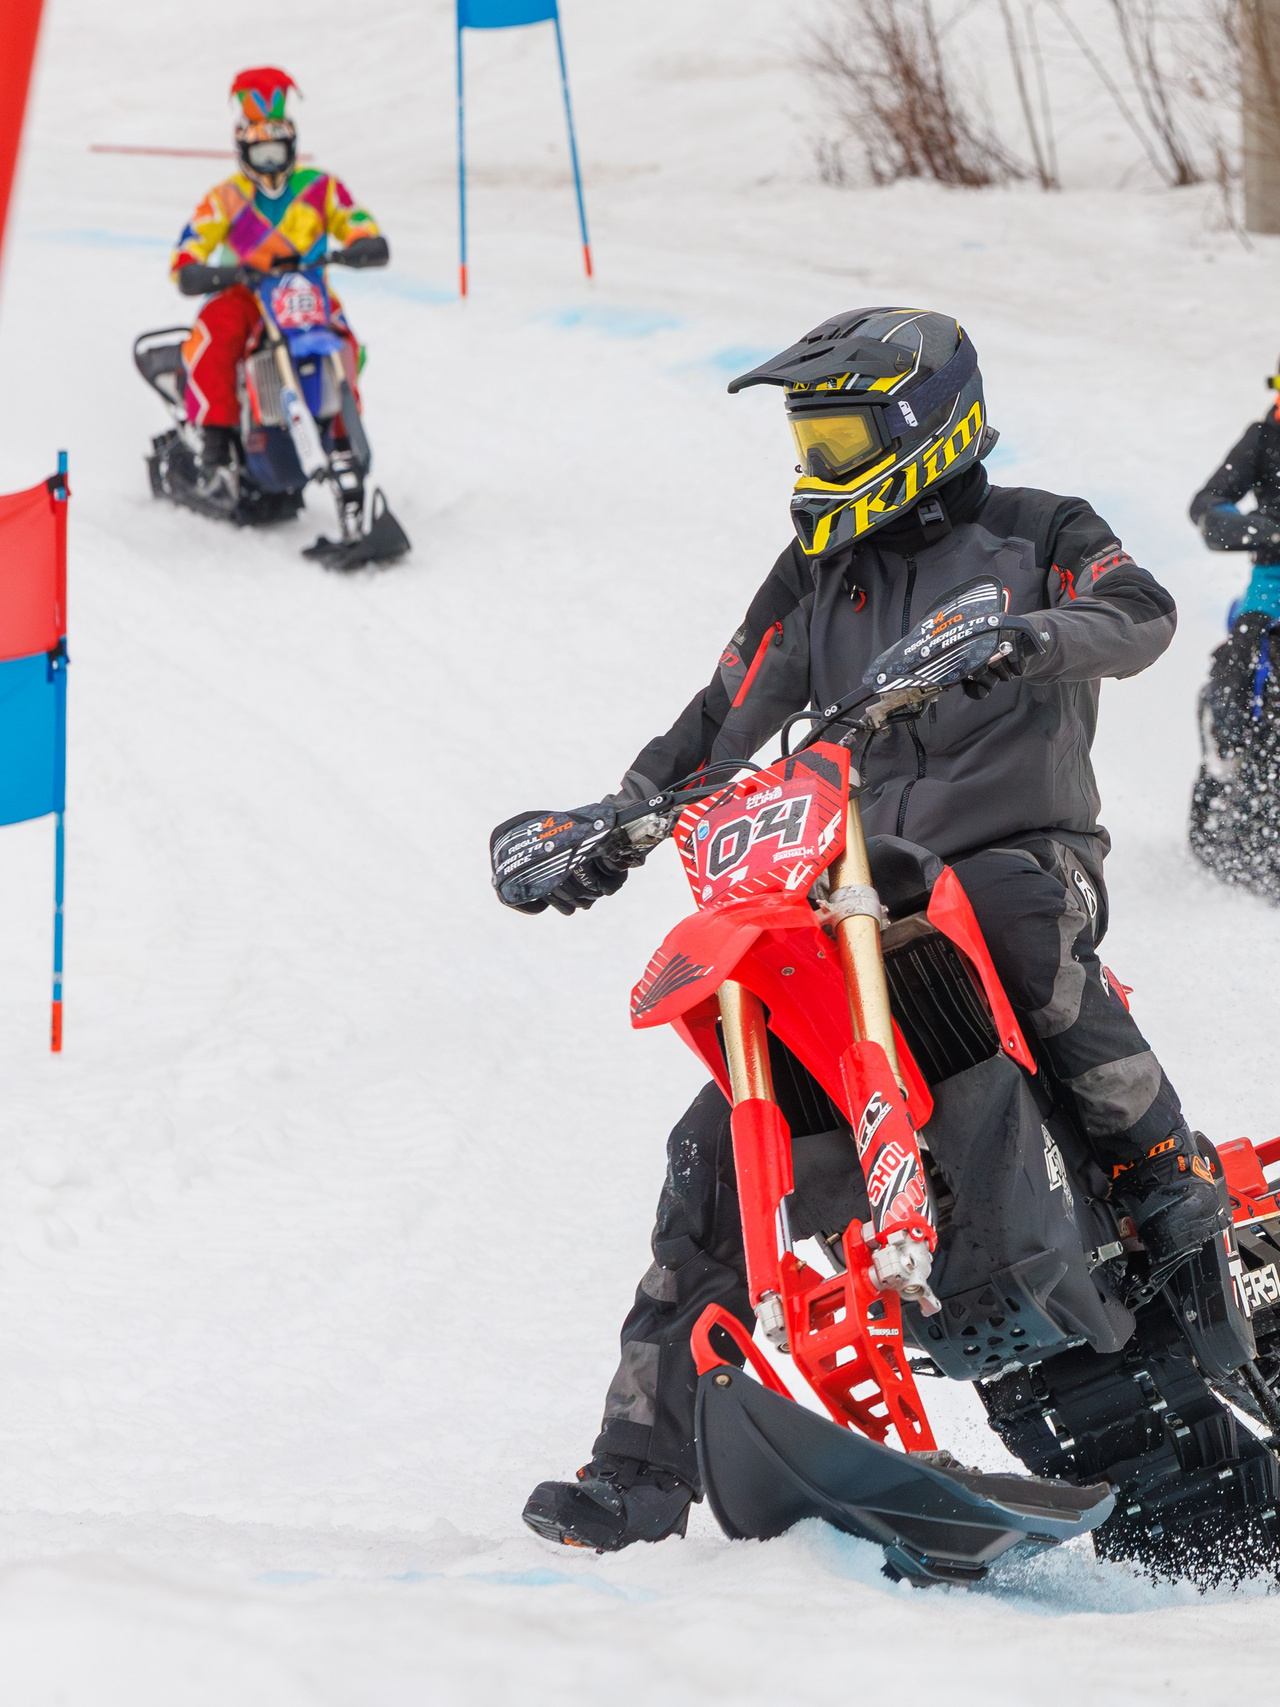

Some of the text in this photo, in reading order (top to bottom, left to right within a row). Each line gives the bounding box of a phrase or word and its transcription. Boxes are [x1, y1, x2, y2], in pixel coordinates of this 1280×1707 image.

[928, 616, 985, 648] READY TO
[941, 627, 974, 649] RACE
[528, 842, 543, 853] TO
[705, 794, 813, 882] 04
[504, 854, 532, 876] RACE
